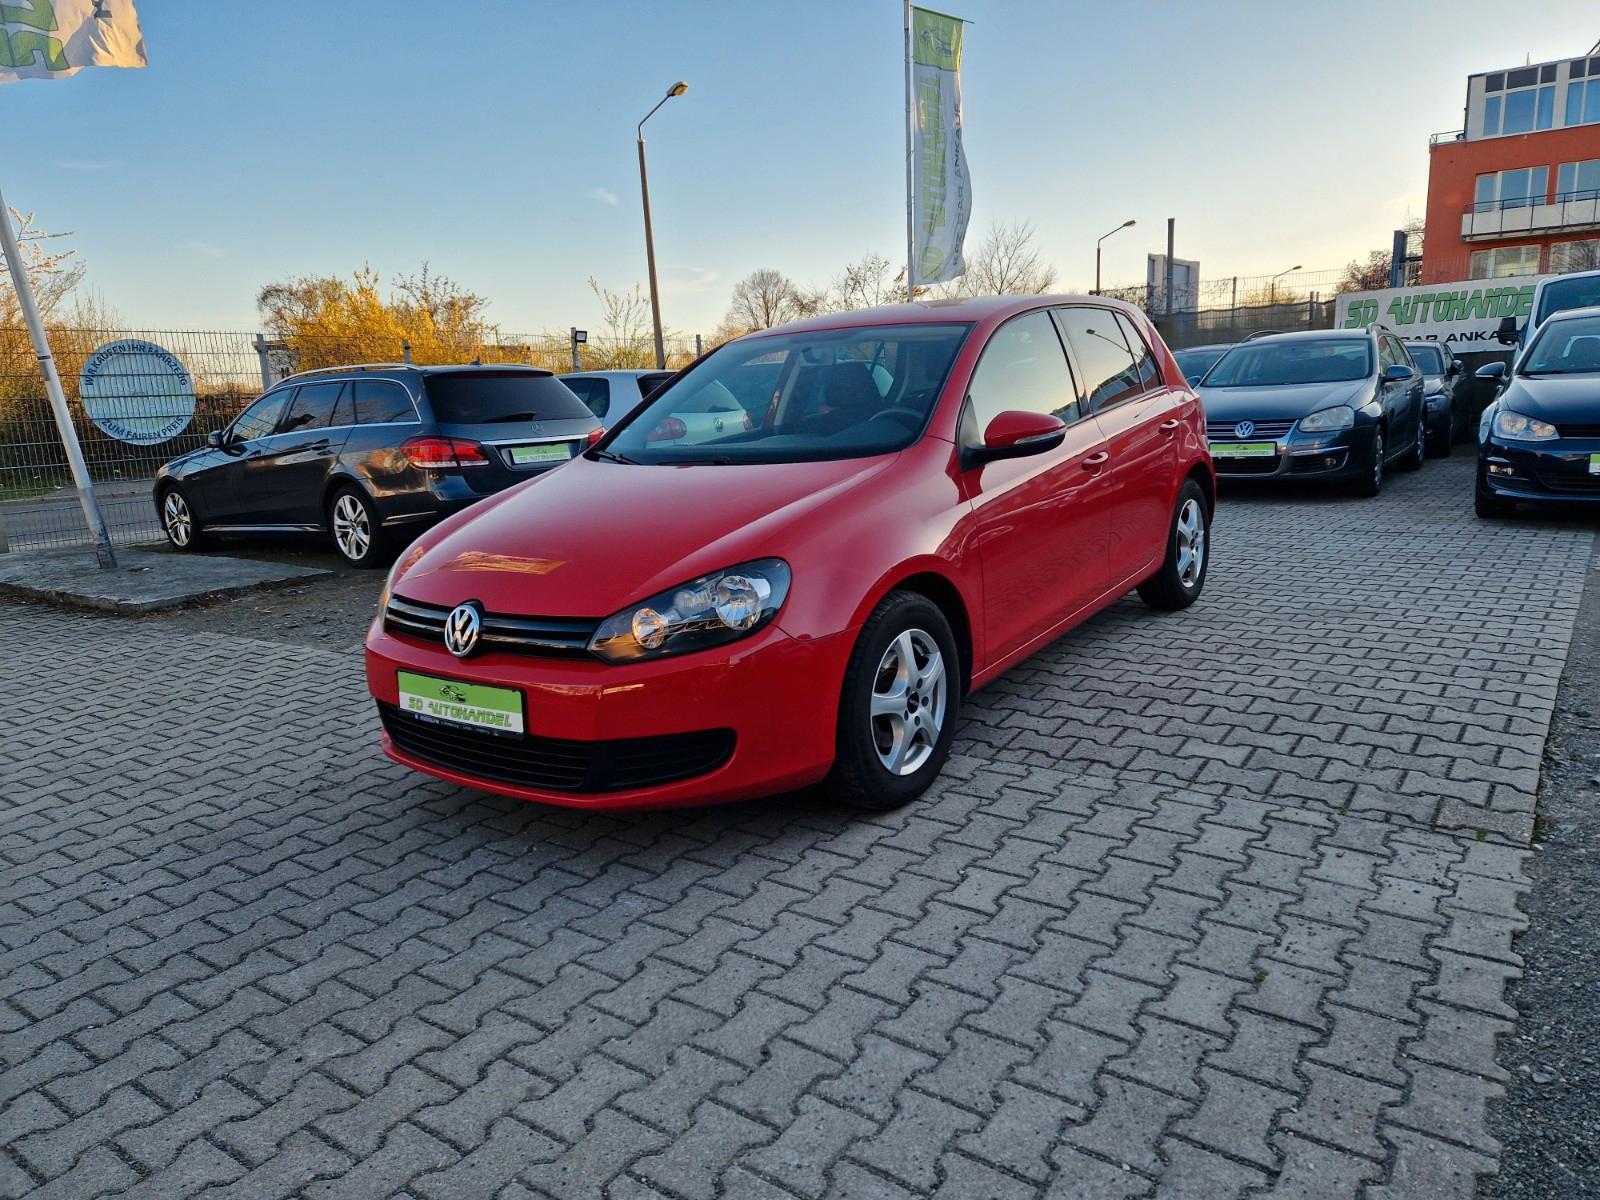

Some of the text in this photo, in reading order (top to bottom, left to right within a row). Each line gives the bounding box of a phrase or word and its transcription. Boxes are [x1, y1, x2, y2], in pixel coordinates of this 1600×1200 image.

[1344, 285, 1536, 329] SD AUTOHANDE
[1445, 330, 1501, 343] ANKA
[84, 344, 188, 386] WIR KAUFEN IHR FAHRZEUG
[101, 416, 184, 440] ZUM FAIREN PREIS
[428, 700, 512, 728] AUTOHANDEL
